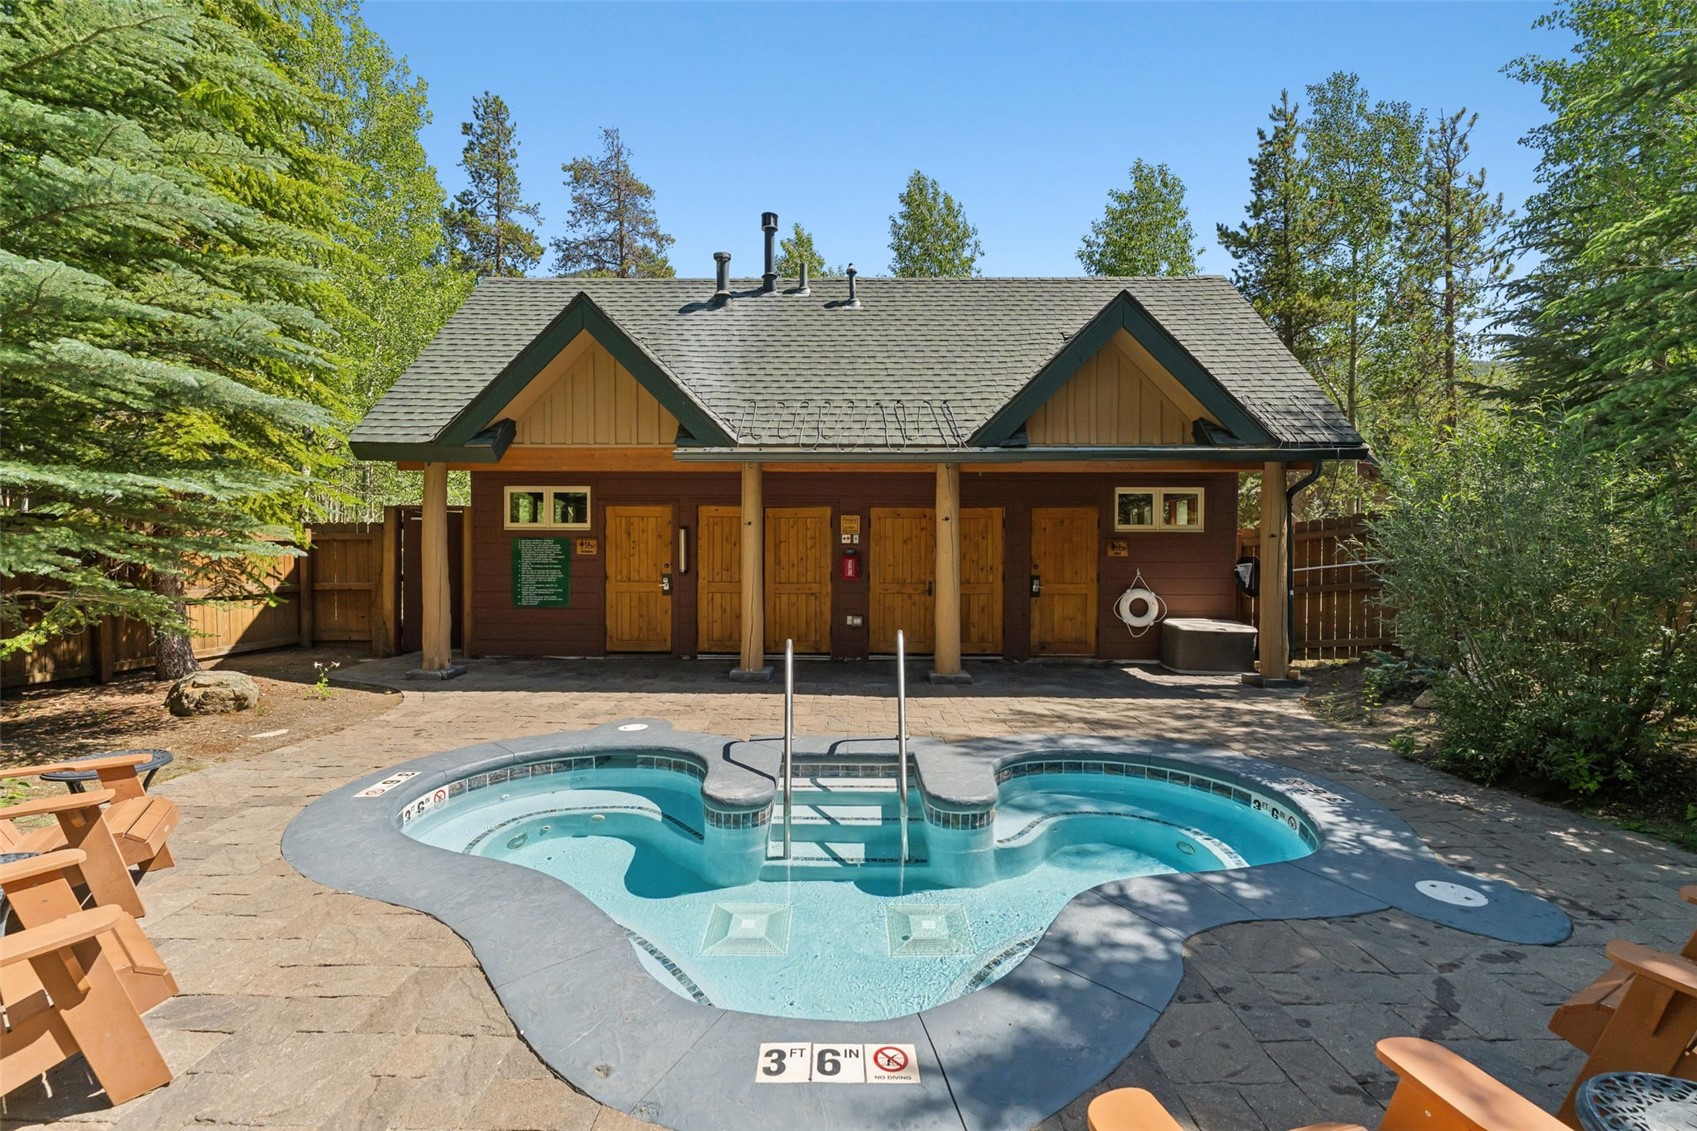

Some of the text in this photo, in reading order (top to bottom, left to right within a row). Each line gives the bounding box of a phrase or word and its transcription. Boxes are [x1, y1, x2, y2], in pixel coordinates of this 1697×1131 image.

[417, 801, 424, 813] 6
[1253, 799, 1261, 810] 3
[1271, 807, 1279, 819] 6
[762, 1048, 860, 1077] 3 FT 6 IN
